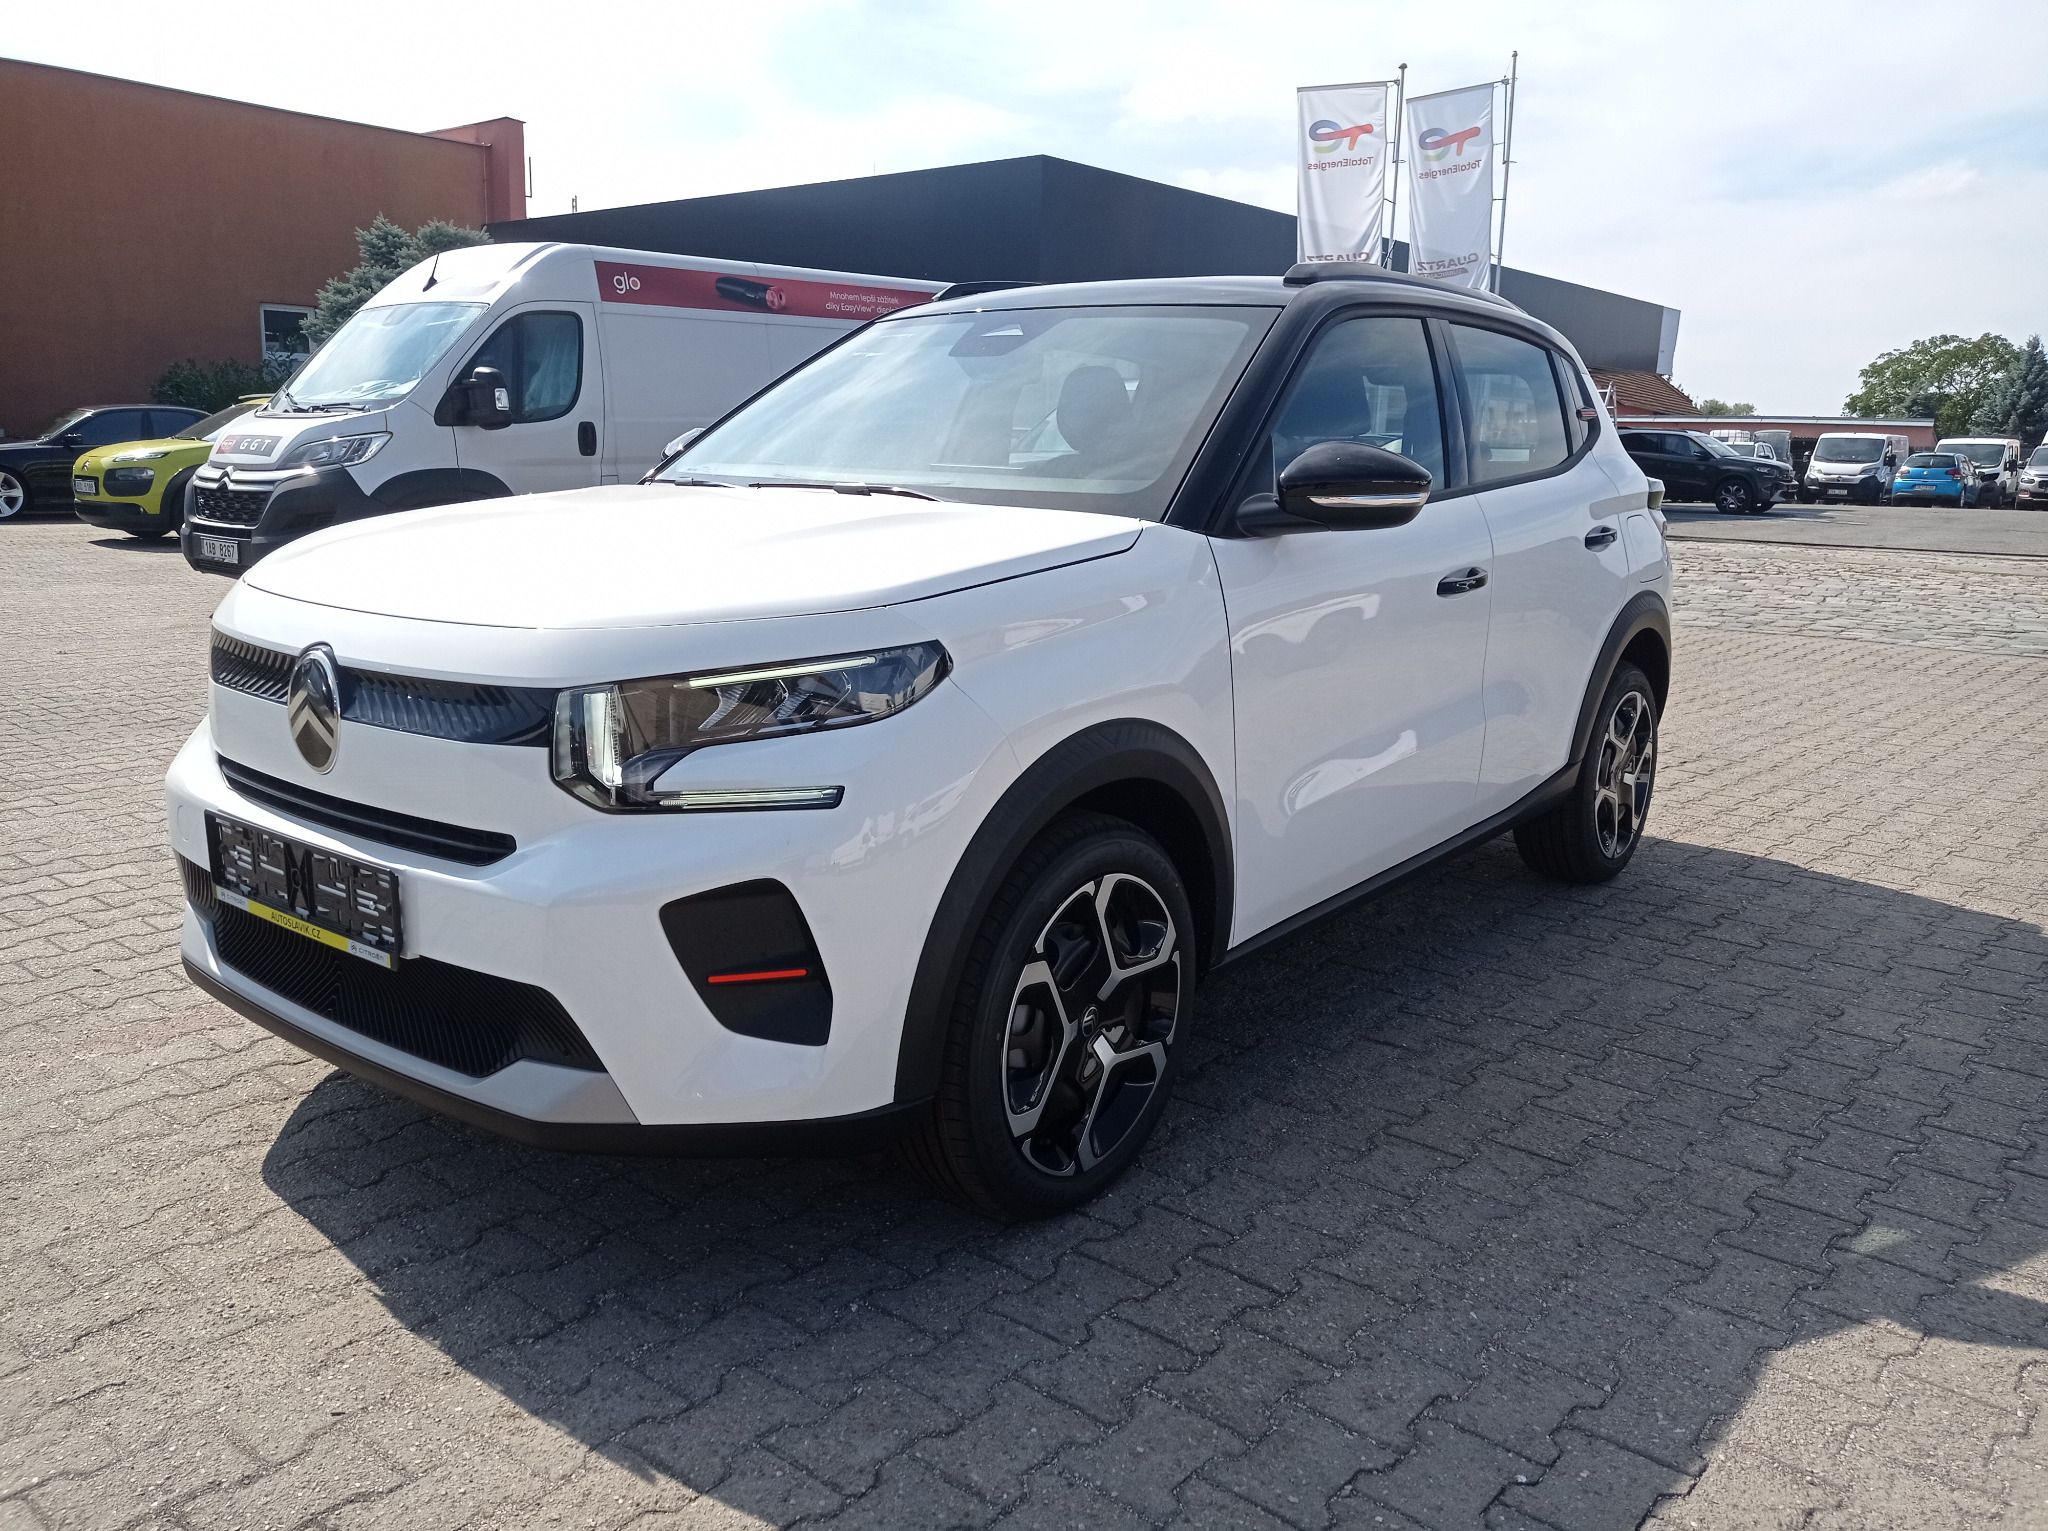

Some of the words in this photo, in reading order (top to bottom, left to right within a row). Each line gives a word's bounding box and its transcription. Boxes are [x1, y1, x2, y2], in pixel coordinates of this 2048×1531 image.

[613, 271, 641, 294] glo
[829, 291, 860, 301] Mnohem
[271, 911, 321, 940] AUTOSLAVIK.CZ
